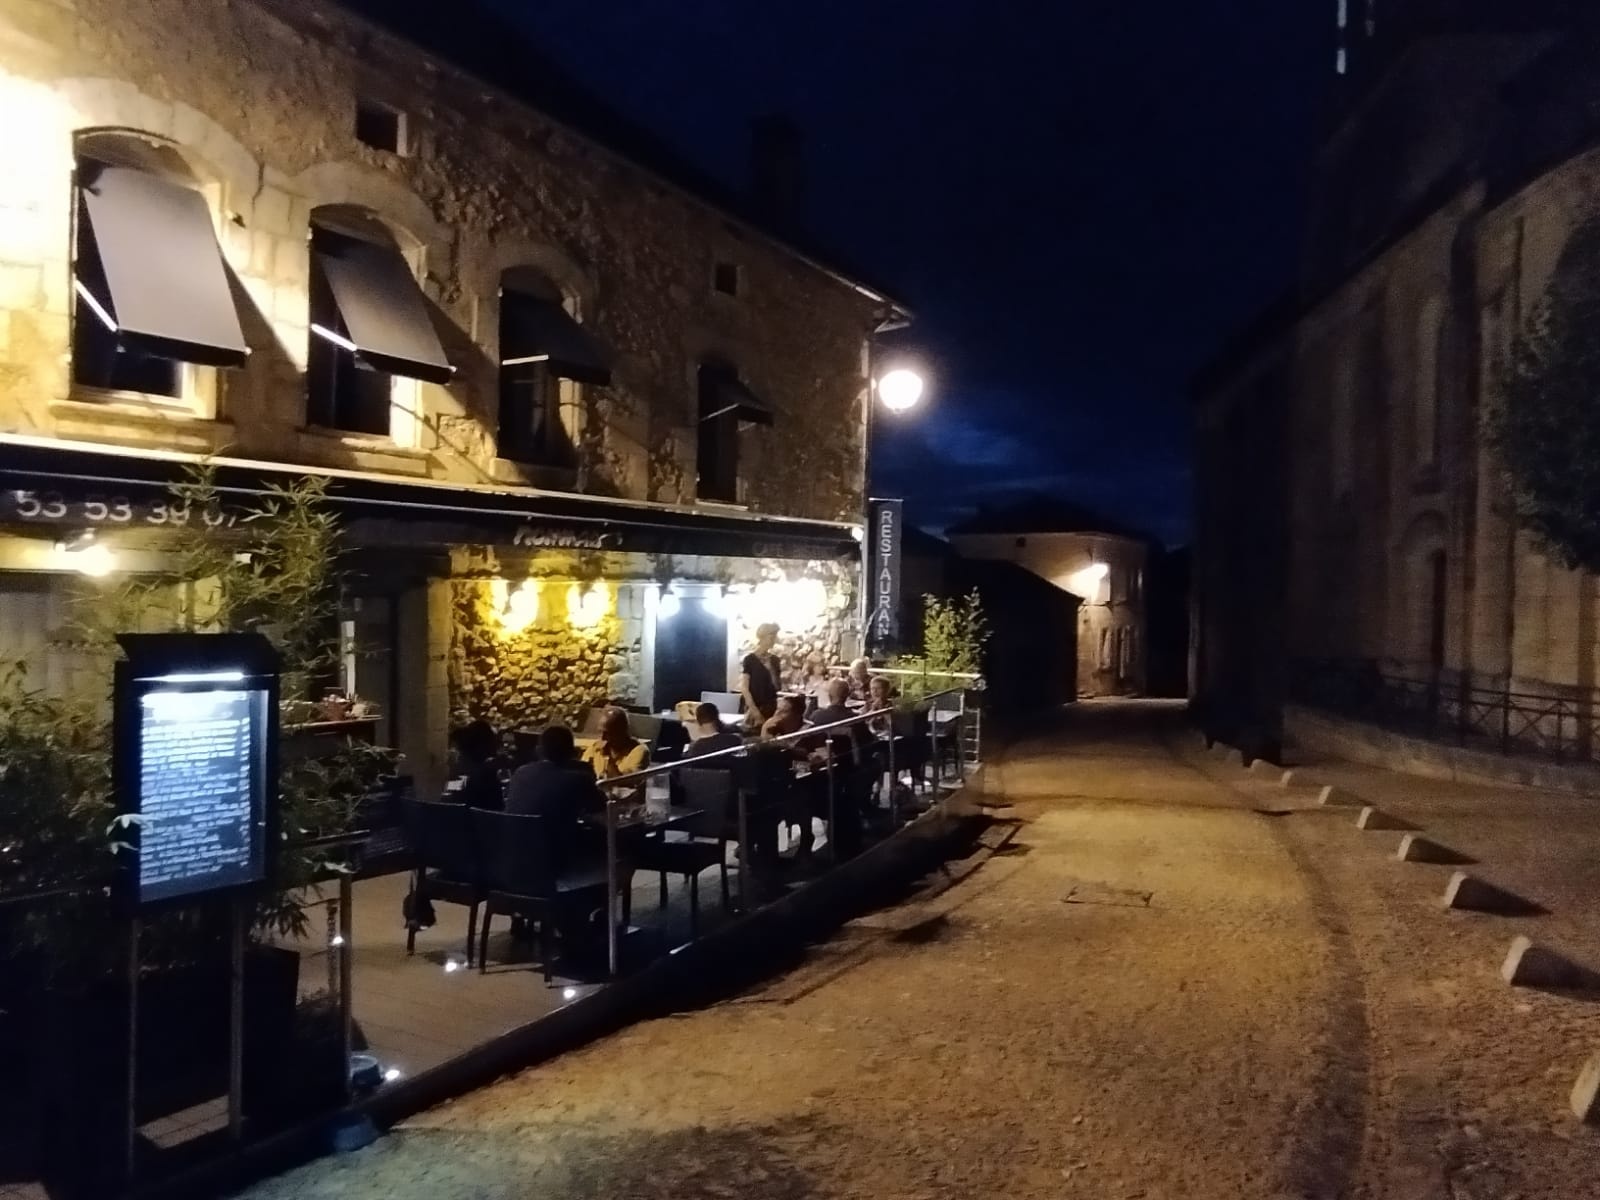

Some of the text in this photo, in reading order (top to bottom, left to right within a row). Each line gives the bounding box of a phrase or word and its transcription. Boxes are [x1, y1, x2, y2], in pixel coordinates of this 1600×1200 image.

[15, 489, 68, 518] 53
[83, 493, 133, 522] 53
[877, 510, 893, 642] RESTAURAN
